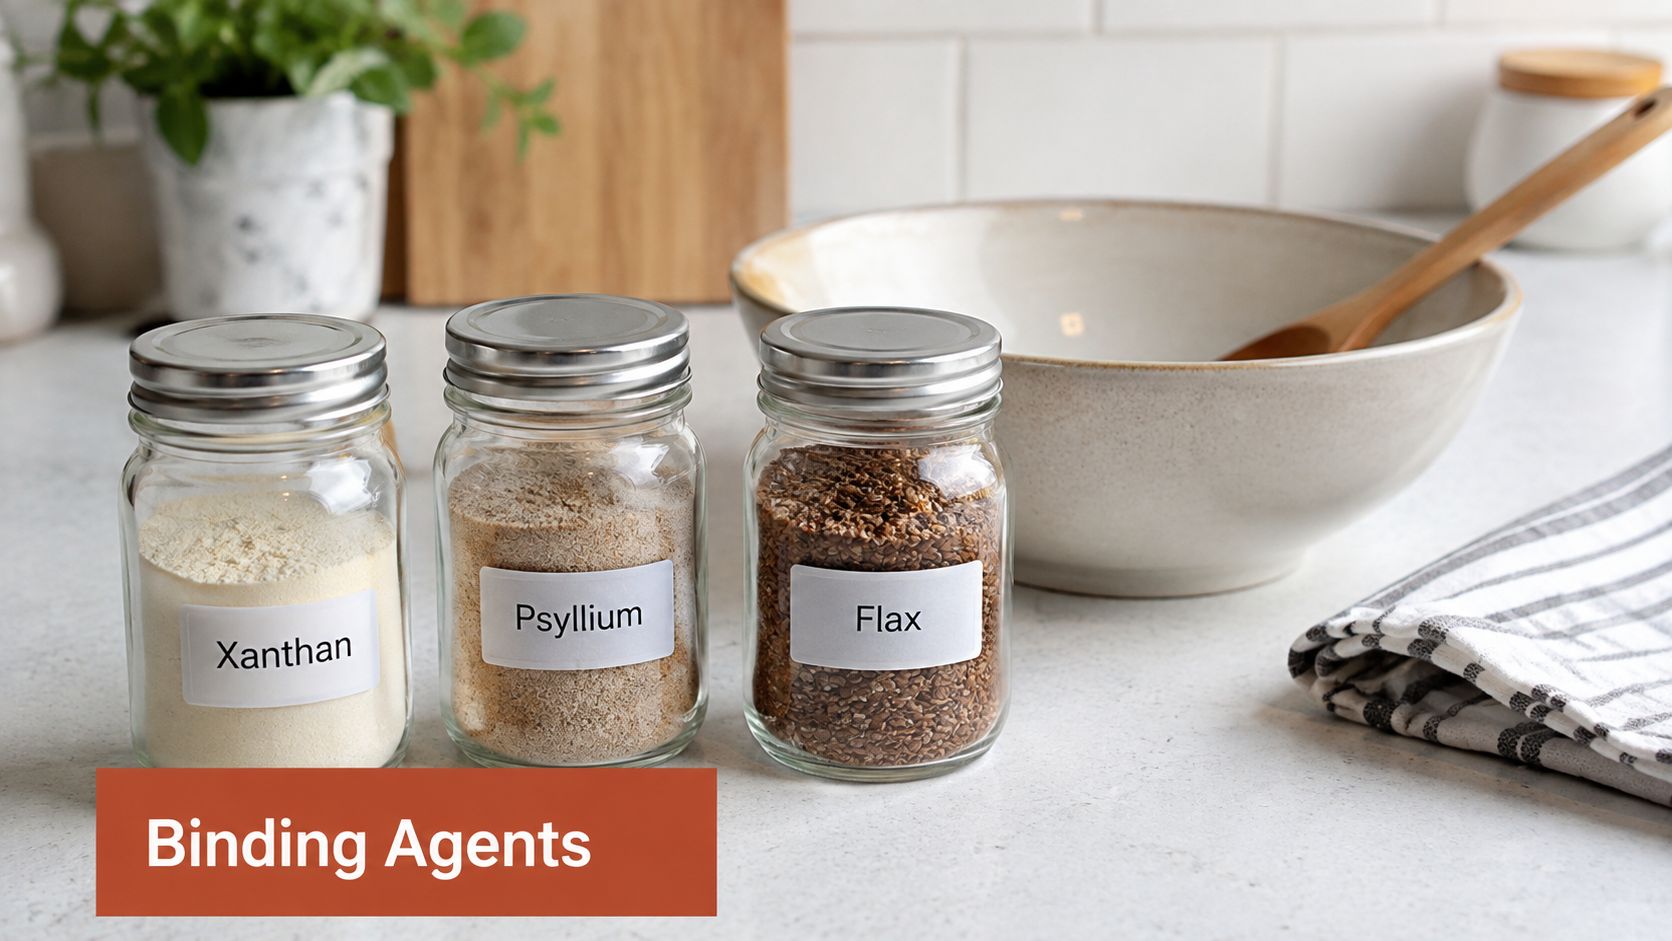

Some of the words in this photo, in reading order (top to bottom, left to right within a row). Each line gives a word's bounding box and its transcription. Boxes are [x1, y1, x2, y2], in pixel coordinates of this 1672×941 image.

[515, 602, 643, 640] Psyllium
[856, 604, 922, 633] Flax
[216, 636, 352, 670] Xanthan
